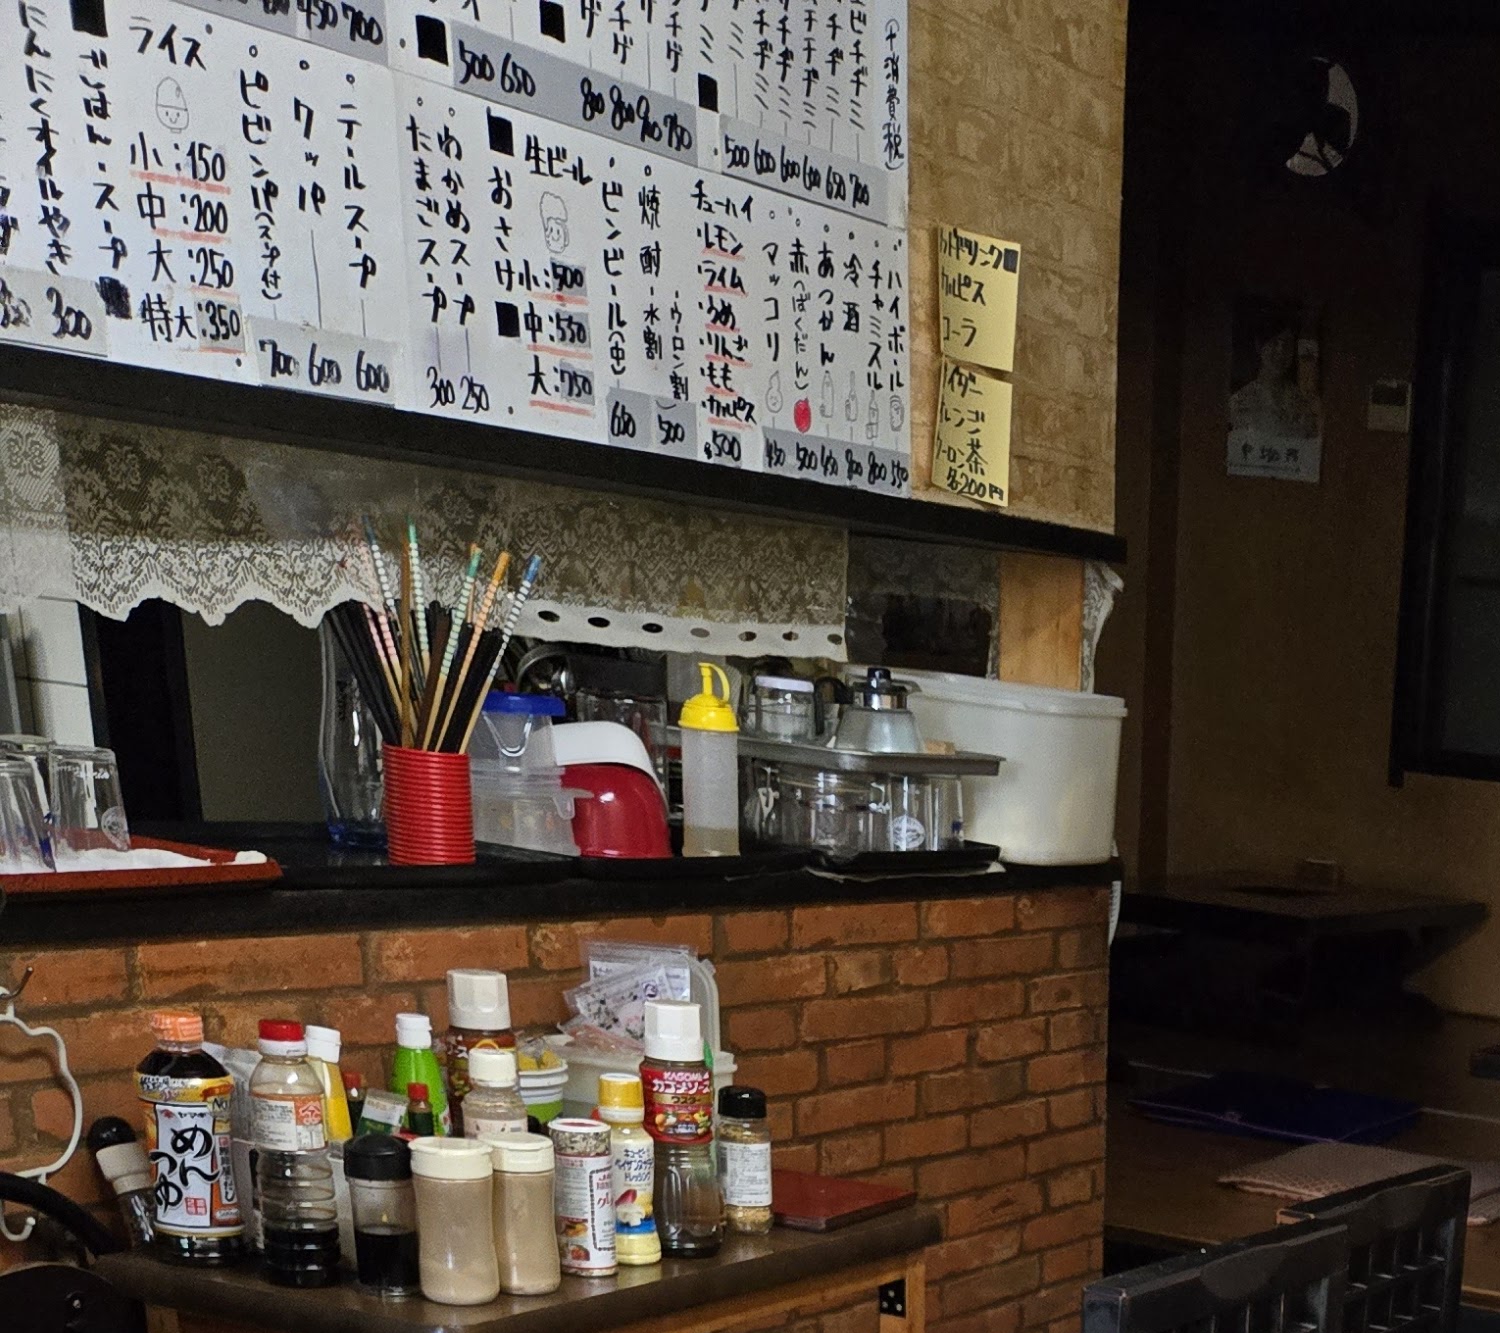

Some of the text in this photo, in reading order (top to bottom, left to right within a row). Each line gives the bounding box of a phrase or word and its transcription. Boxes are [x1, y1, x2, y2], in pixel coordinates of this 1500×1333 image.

[129, 16, 206, 71] ライス
[342, 2, 383, 45] 700
[459, 39, 536, 97] 500 650
[525, 134, 593, 185] 生ビール
[725, 135, 749, 168] 500
[754, 139, 776, 174] 600
[780, 145, 800, 182] 600
[336, 104, 377, 288] テールスープ
[406, 113, 447, 323] たまごスープ
[691, 179, 753, 222] チューハイ
[437, 124, 475, 326] わかめスープ
[488, 166, 515, 291] おさけ
[46, 286, 92, 340] 300
[761, 242, 779, 362] マッコリ
[817, 242, 835, 366] あつかん
[843, 253, 863, 333] 冷酒
[867, 259, 884, 391] チャミスル
[942, 316, 977, 348] コーラ
[259, 339, 299, 377] 700
[309, 343, 342, 386] 600
[356, 350, 391, 393] 600
[427, 366, 455, 407] 300
[658, 413, 685, 445] 500
